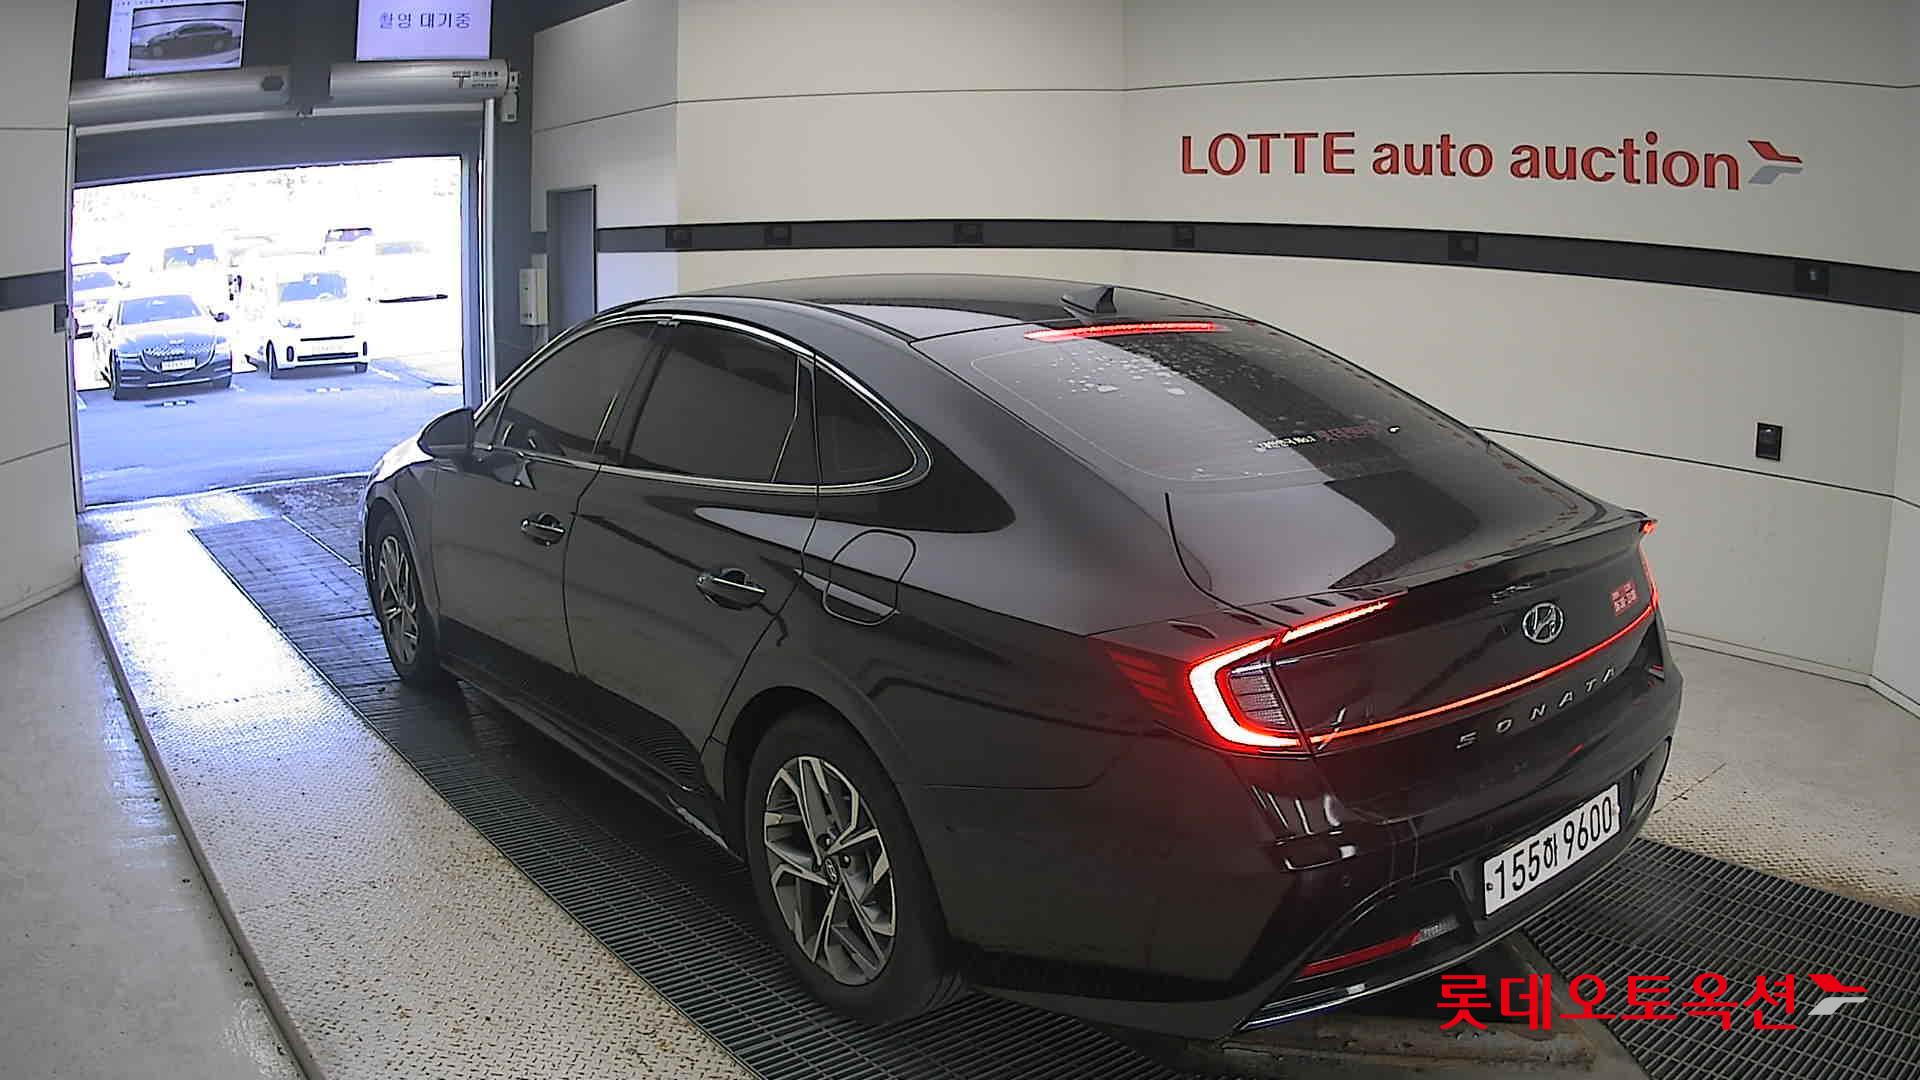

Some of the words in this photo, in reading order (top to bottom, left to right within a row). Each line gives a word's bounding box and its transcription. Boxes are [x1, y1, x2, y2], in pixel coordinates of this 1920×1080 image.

[420, 12, 471, 29] 대기중
[1181, 131, 1355, 176] LOTTE
[1372, 134, 1493, 177] auto
[1510, 131, 1739, 190] auction
[1456, 667, 1614, 749] SONATA
[1494, 833, 1558, 899] 155하
[1563, 796, 1612, 860] 9600
